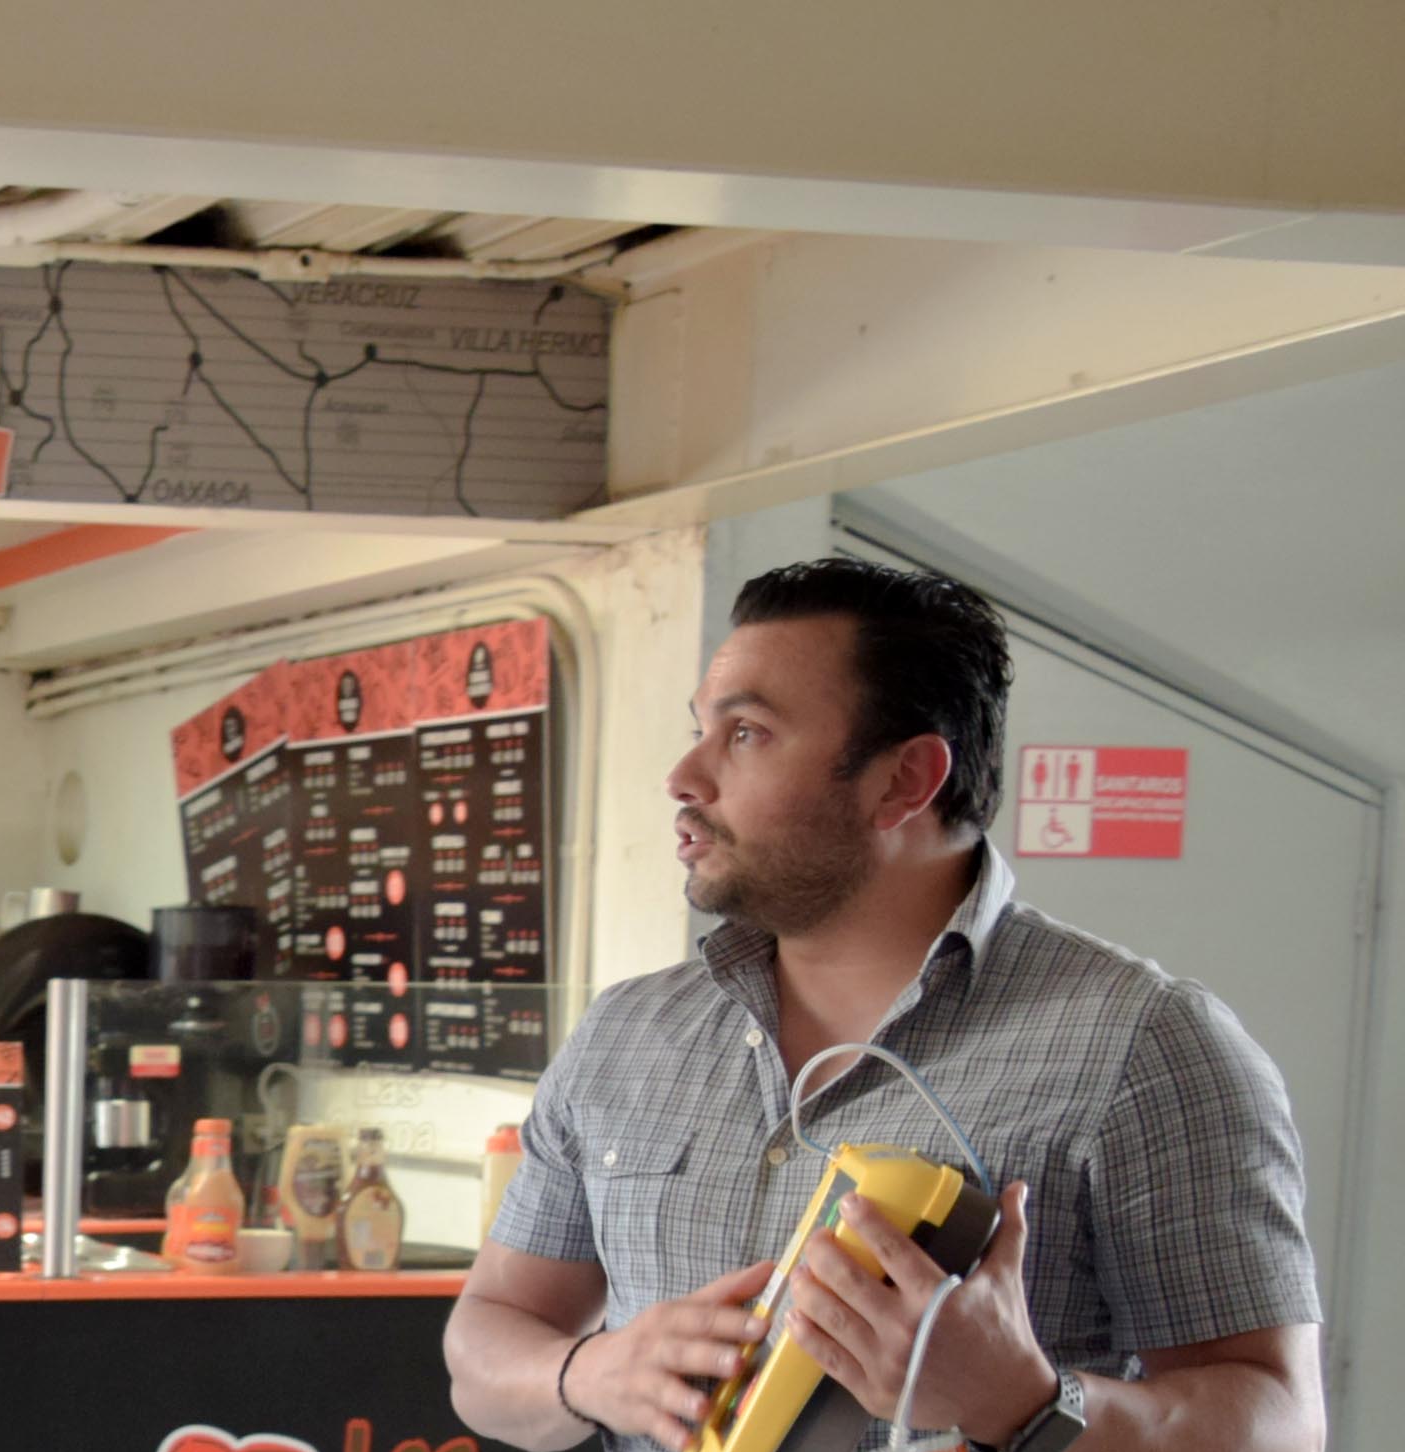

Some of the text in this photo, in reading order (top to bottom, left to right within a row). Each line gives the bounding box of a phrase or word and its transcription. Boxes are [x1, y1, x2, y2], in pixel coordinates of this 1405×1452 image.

[291, 282, 422, 310] VERACRUZ
[450, 327, 512, 352] VILLA
[518, 329, 609, 359] HERMO
[152, 478, 251, 506] OAXACA
